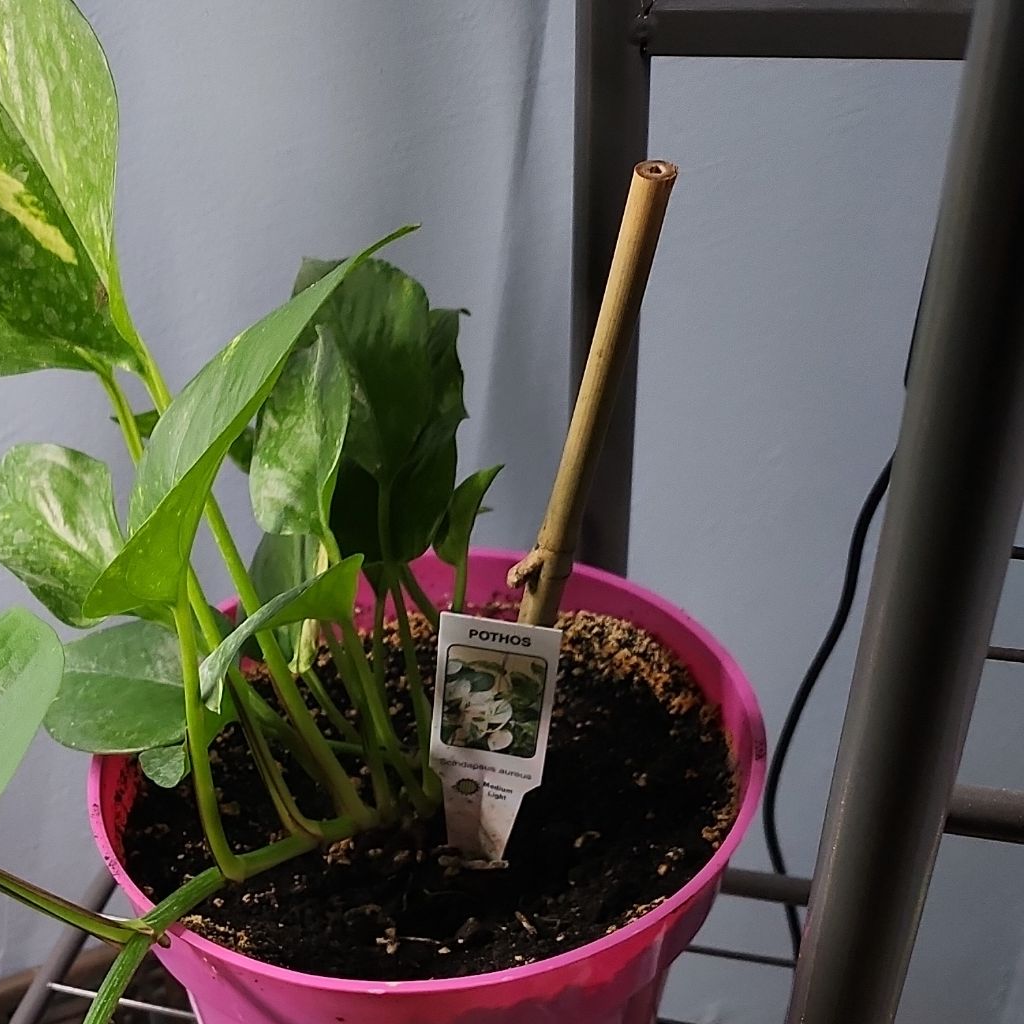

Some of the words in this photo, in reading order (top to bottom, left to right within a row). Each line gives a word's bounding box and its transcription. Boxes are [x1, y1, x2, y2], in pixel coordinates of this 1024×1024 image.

[469, 629, 531, 647] POTHOS
[498, 767, 532, 780] aureus
[483, 781, 513, 794] Medium
[488, 791, 507, 801] Light
